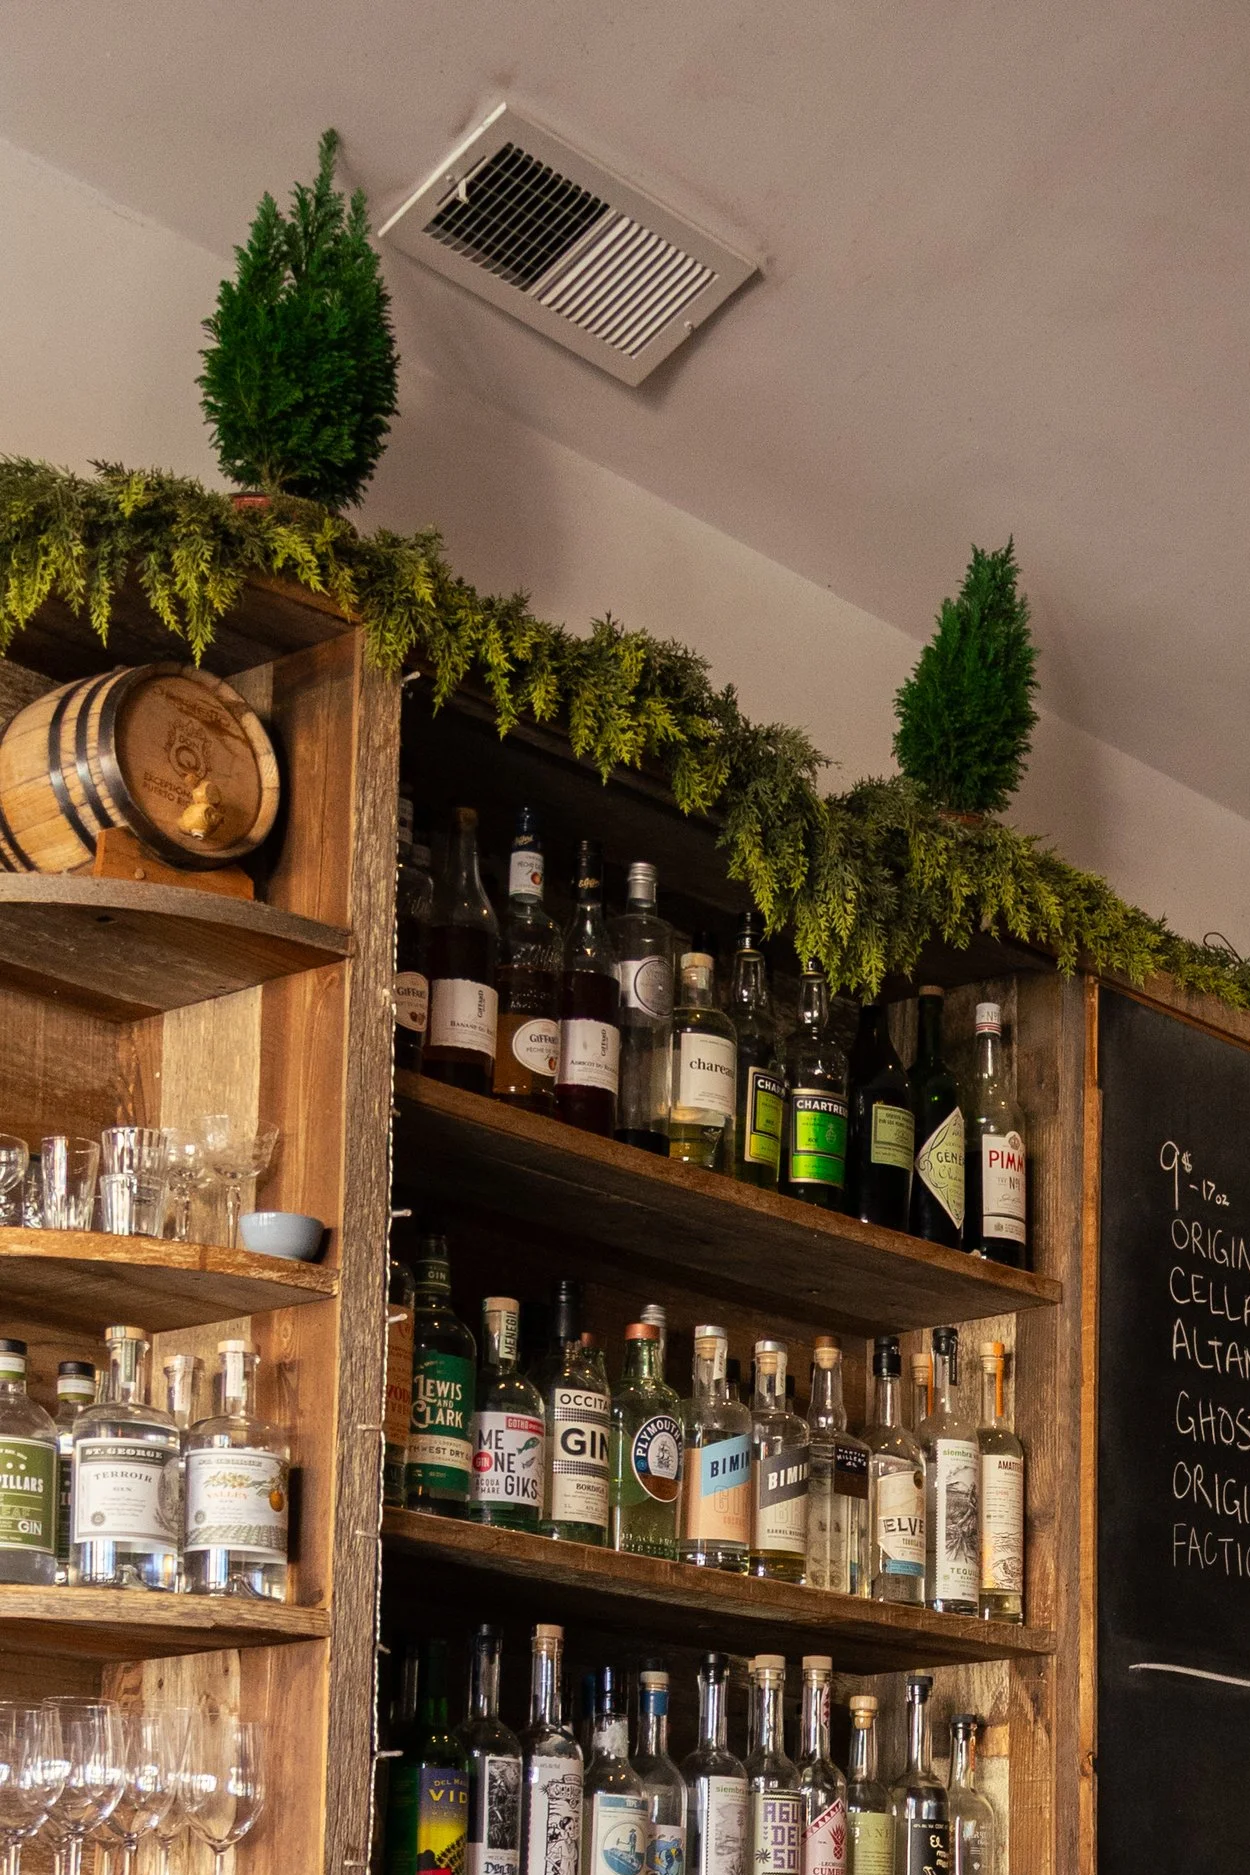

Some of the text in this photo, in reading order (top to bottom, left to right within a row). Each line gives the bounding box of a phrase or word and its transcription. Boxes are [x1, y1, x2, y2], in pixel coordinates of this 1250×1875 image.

[414, 1374, 463, 1402] LEWIS
[411, 1400, 463, 1429] CLARK
[437, 1400, 454, 1409] AND
[478, 1429, 505, 1451] ME
[636, 1419, 681, 1458] PLYMOUTH
[107, 1448, 163, 1460] GEORGE
[493, 1451, 517, 1474] NE
[95, 1470, 153, 1483] TERROIR
[504, 1475, 538, 1500] GIKS
[18, 1520, 43, 1536] GIN
